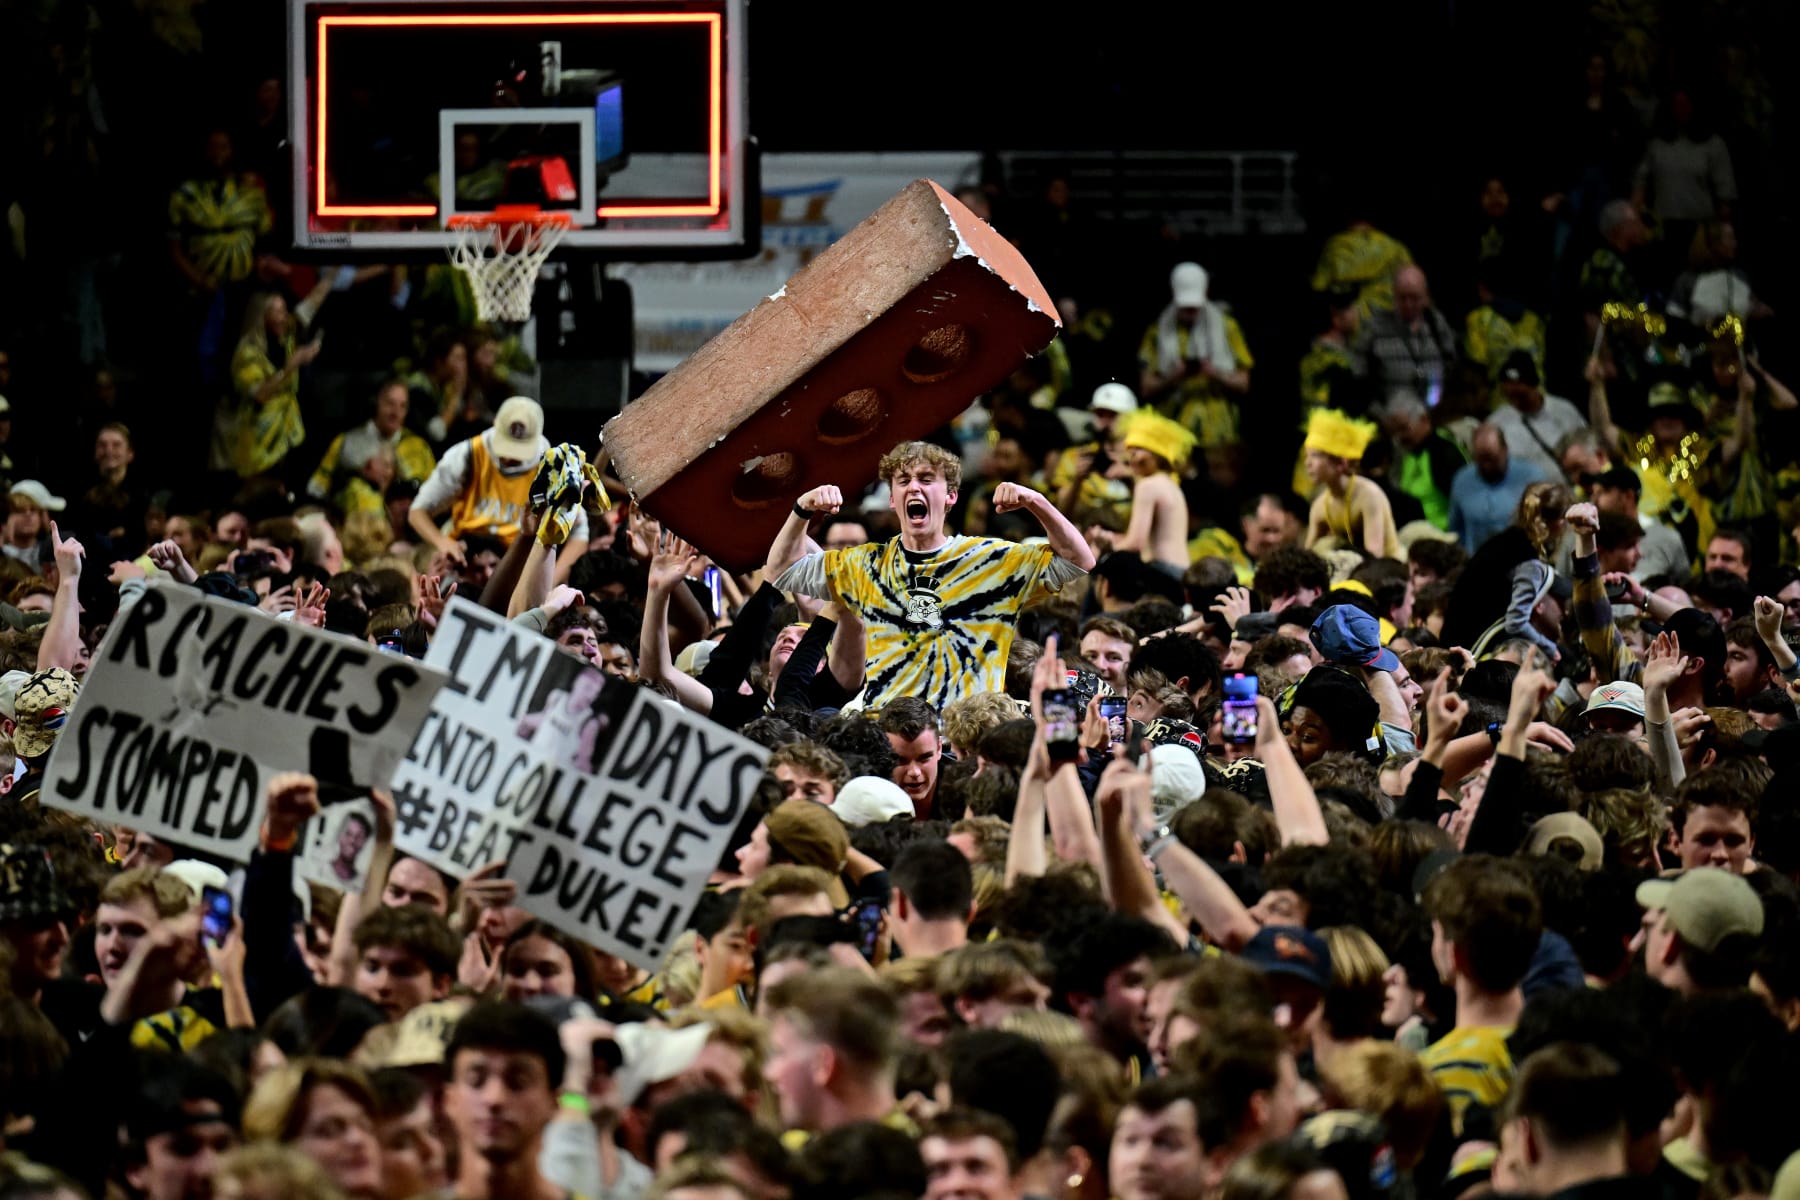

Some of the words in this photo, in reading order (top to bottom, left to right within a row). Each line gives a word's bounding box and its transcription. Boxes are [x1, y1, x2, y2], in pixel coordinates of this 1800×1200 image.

[56, 706, 260, 840] STOMPED
[405, 709, 498, 794] INTO
[494, 752, 709, 888] COLLEGE
[608, 702, 762, 825] DAYS
[391, 781, 533, 879] #BEAT
[526, 846, 684, 957] DUKE!
